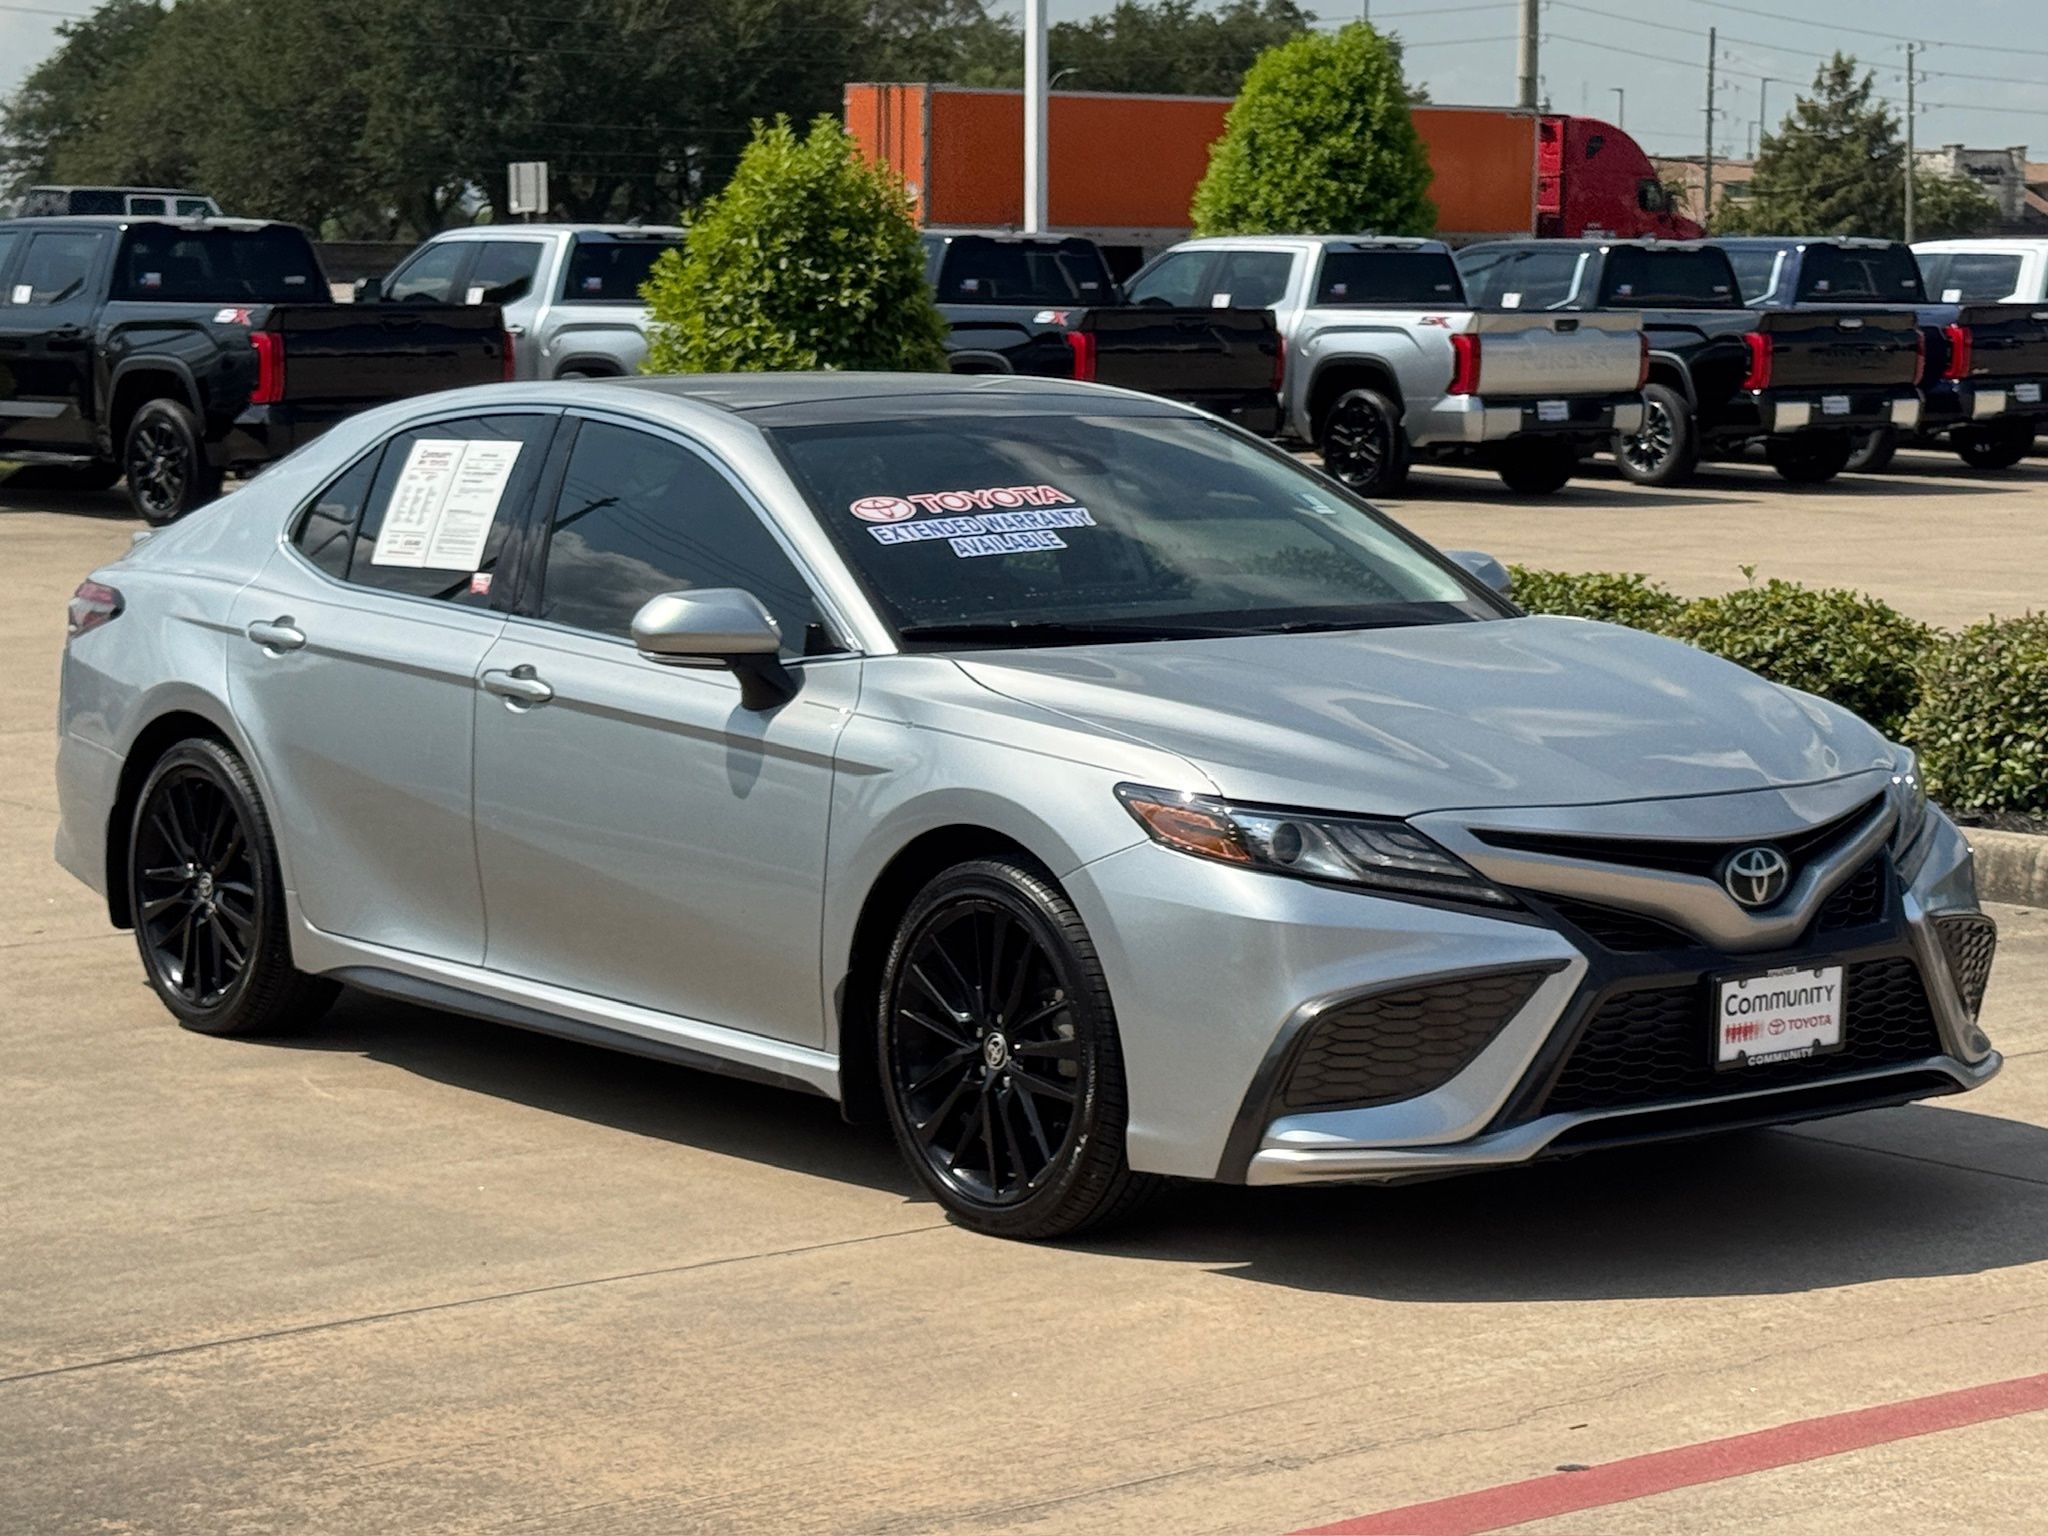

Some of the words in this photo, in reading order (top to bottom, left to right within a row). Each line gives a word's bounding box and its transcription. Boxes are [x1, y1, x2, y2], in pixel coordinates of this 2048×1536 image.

[908, 485, 1075, 513] TOYOTA
[871, 517, 985, 543] EXTENDED
[980, 509, 1094, 533] WARRANTY
[951, 532, 1063, 556] AVAILABLE
[1787, 1014, 1832, 1030] TOYOTA
[1747, 1048, 1813, 1066] COMMUNITY
